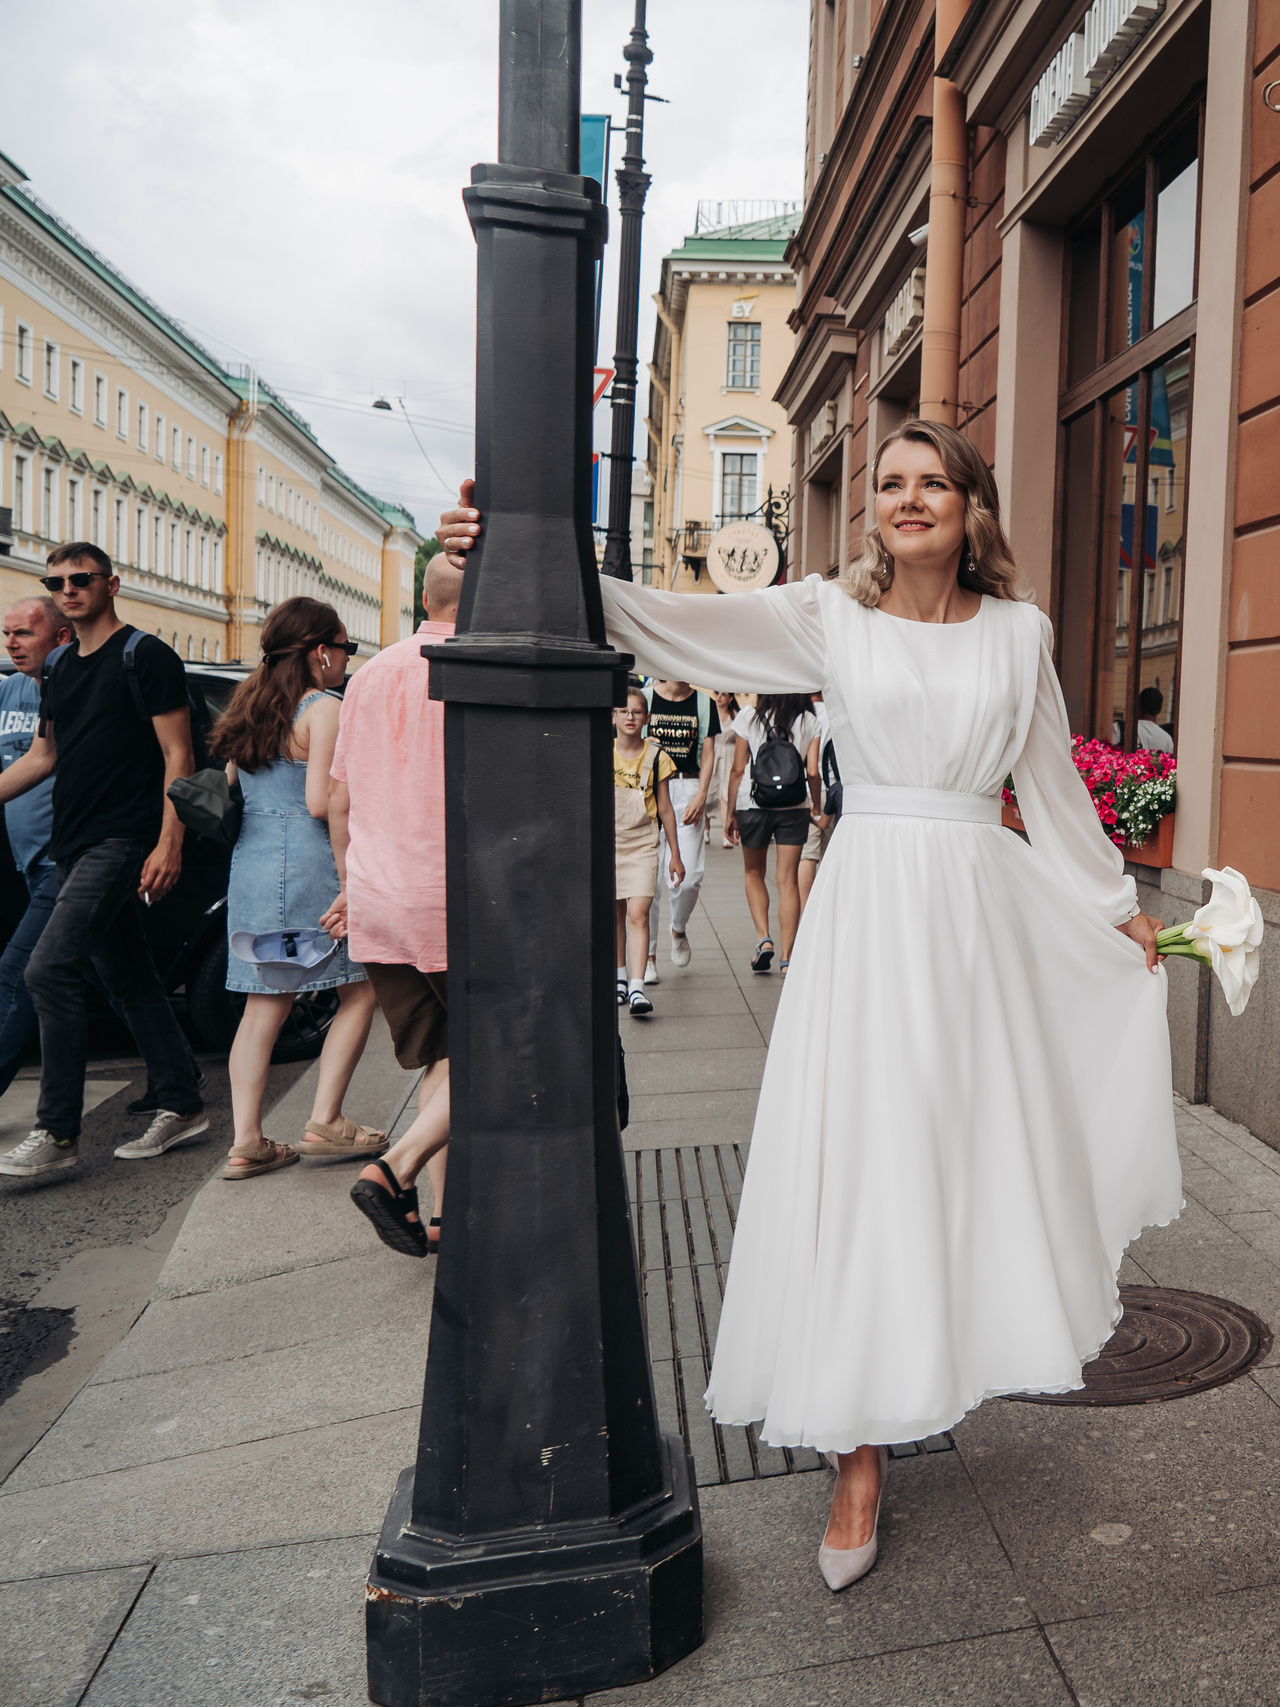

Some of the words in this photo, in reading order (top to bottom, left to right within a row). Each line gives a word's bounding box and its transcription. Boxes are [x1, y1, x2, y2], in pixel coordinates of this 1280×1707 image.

[1029, 32, 1084, 147] CINEMA
[1084, 0, 1146, 78] LOUN
[732, 296, 757, 318] EY
[0, 710, 41, 736] LEGEN
